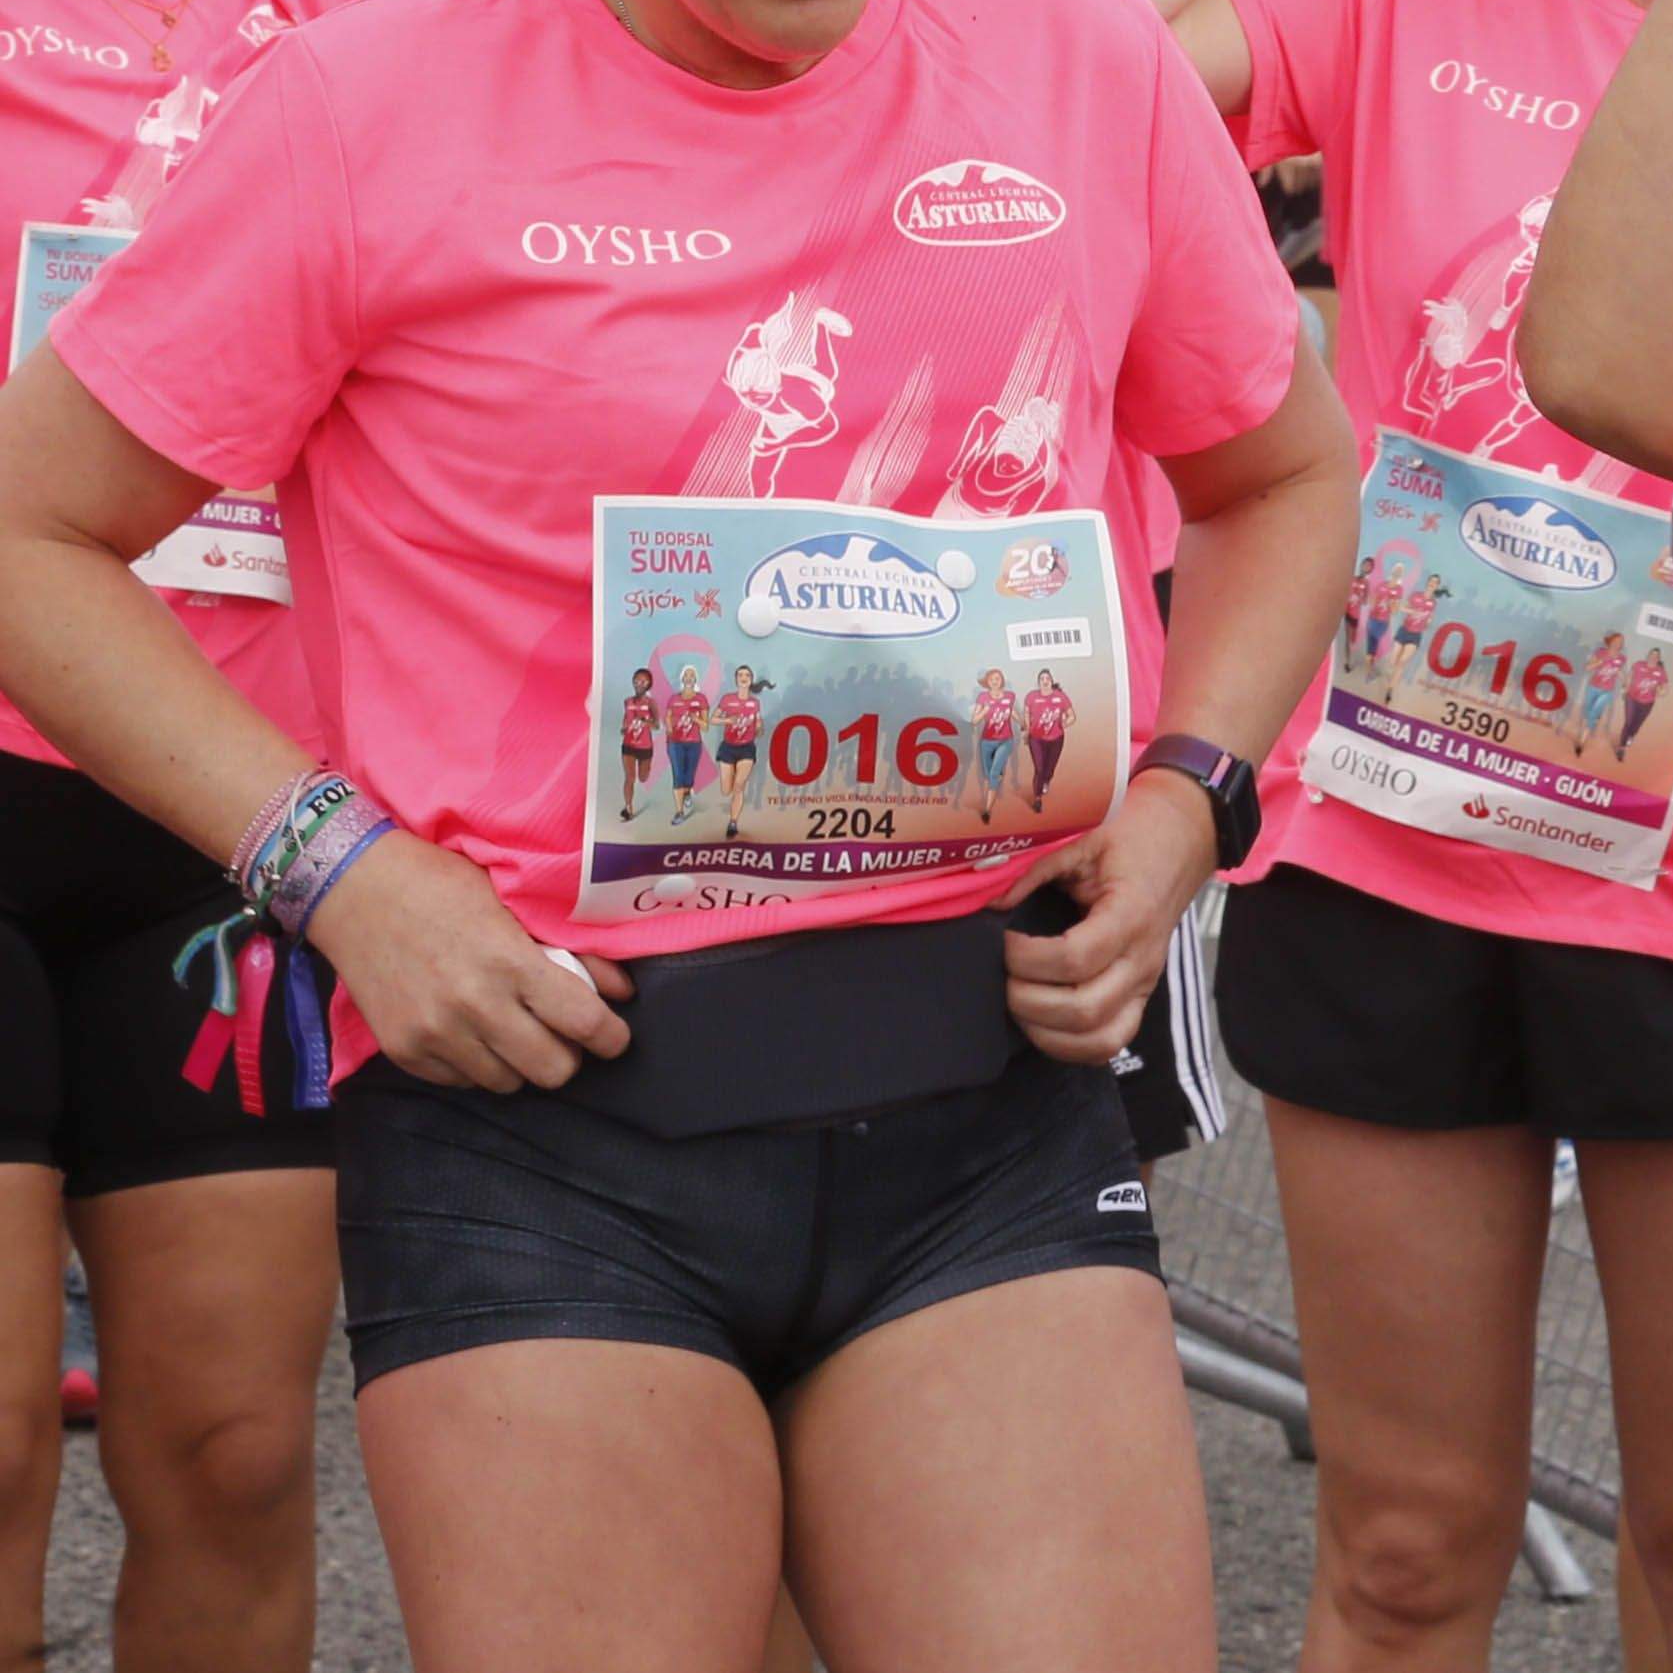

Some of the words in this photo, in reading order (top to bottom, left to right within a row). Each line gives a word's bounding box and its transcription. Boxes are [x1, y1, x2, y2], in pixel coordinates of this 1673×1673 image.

[1430, 60, 1580, 130] OYSHO
[906, 193, 1057, 229] ASTURIANA
[521, 221, 732, 266] OYSHO
[46, 262, 93, 283] SUM
[1388, 467, 1444, 502] SUMA
[202, 502, 263, 526] MUJER
[629, 531, 649, 547] TU
[654, 530, 714, 547] DORSAL
[1468, 513, 1602, 583] ASTURIANA
[231, 550, 288, 577] Santa
[630, 548, 713, 575] SUMA
[799, 565, 869, 579] CENTRAL
[623, 588, 686, 618] gijón
[768, 568, 947, 621] ASTURIANA
[1427, 621, 1575, 713] 016
[1440, 701, 1511, 744] 3590
[769, 713, 960, 787] 016
[1356, 706, 1411, 744] CARRERA
[1416, 729, 1442, 753] DE
[1446, 738, 1470, 764] LA
[1474, 748, 1542, 786] MUJER
[1554, 773, 1614, 809] GIJÓN
[1331, 743, 1418, 797] OYSHO
[806, 808, 896, 840] 2204
[1493, 805, 1616, 856] Santander
[663, 848, 775, 870] CARRERA
[783, 852, 816, 872] DE
[822, 851, 853, 873] LA
[860, 847, 943, 872] MUJER
[964, 836, 1033, 860] GIJÓN
